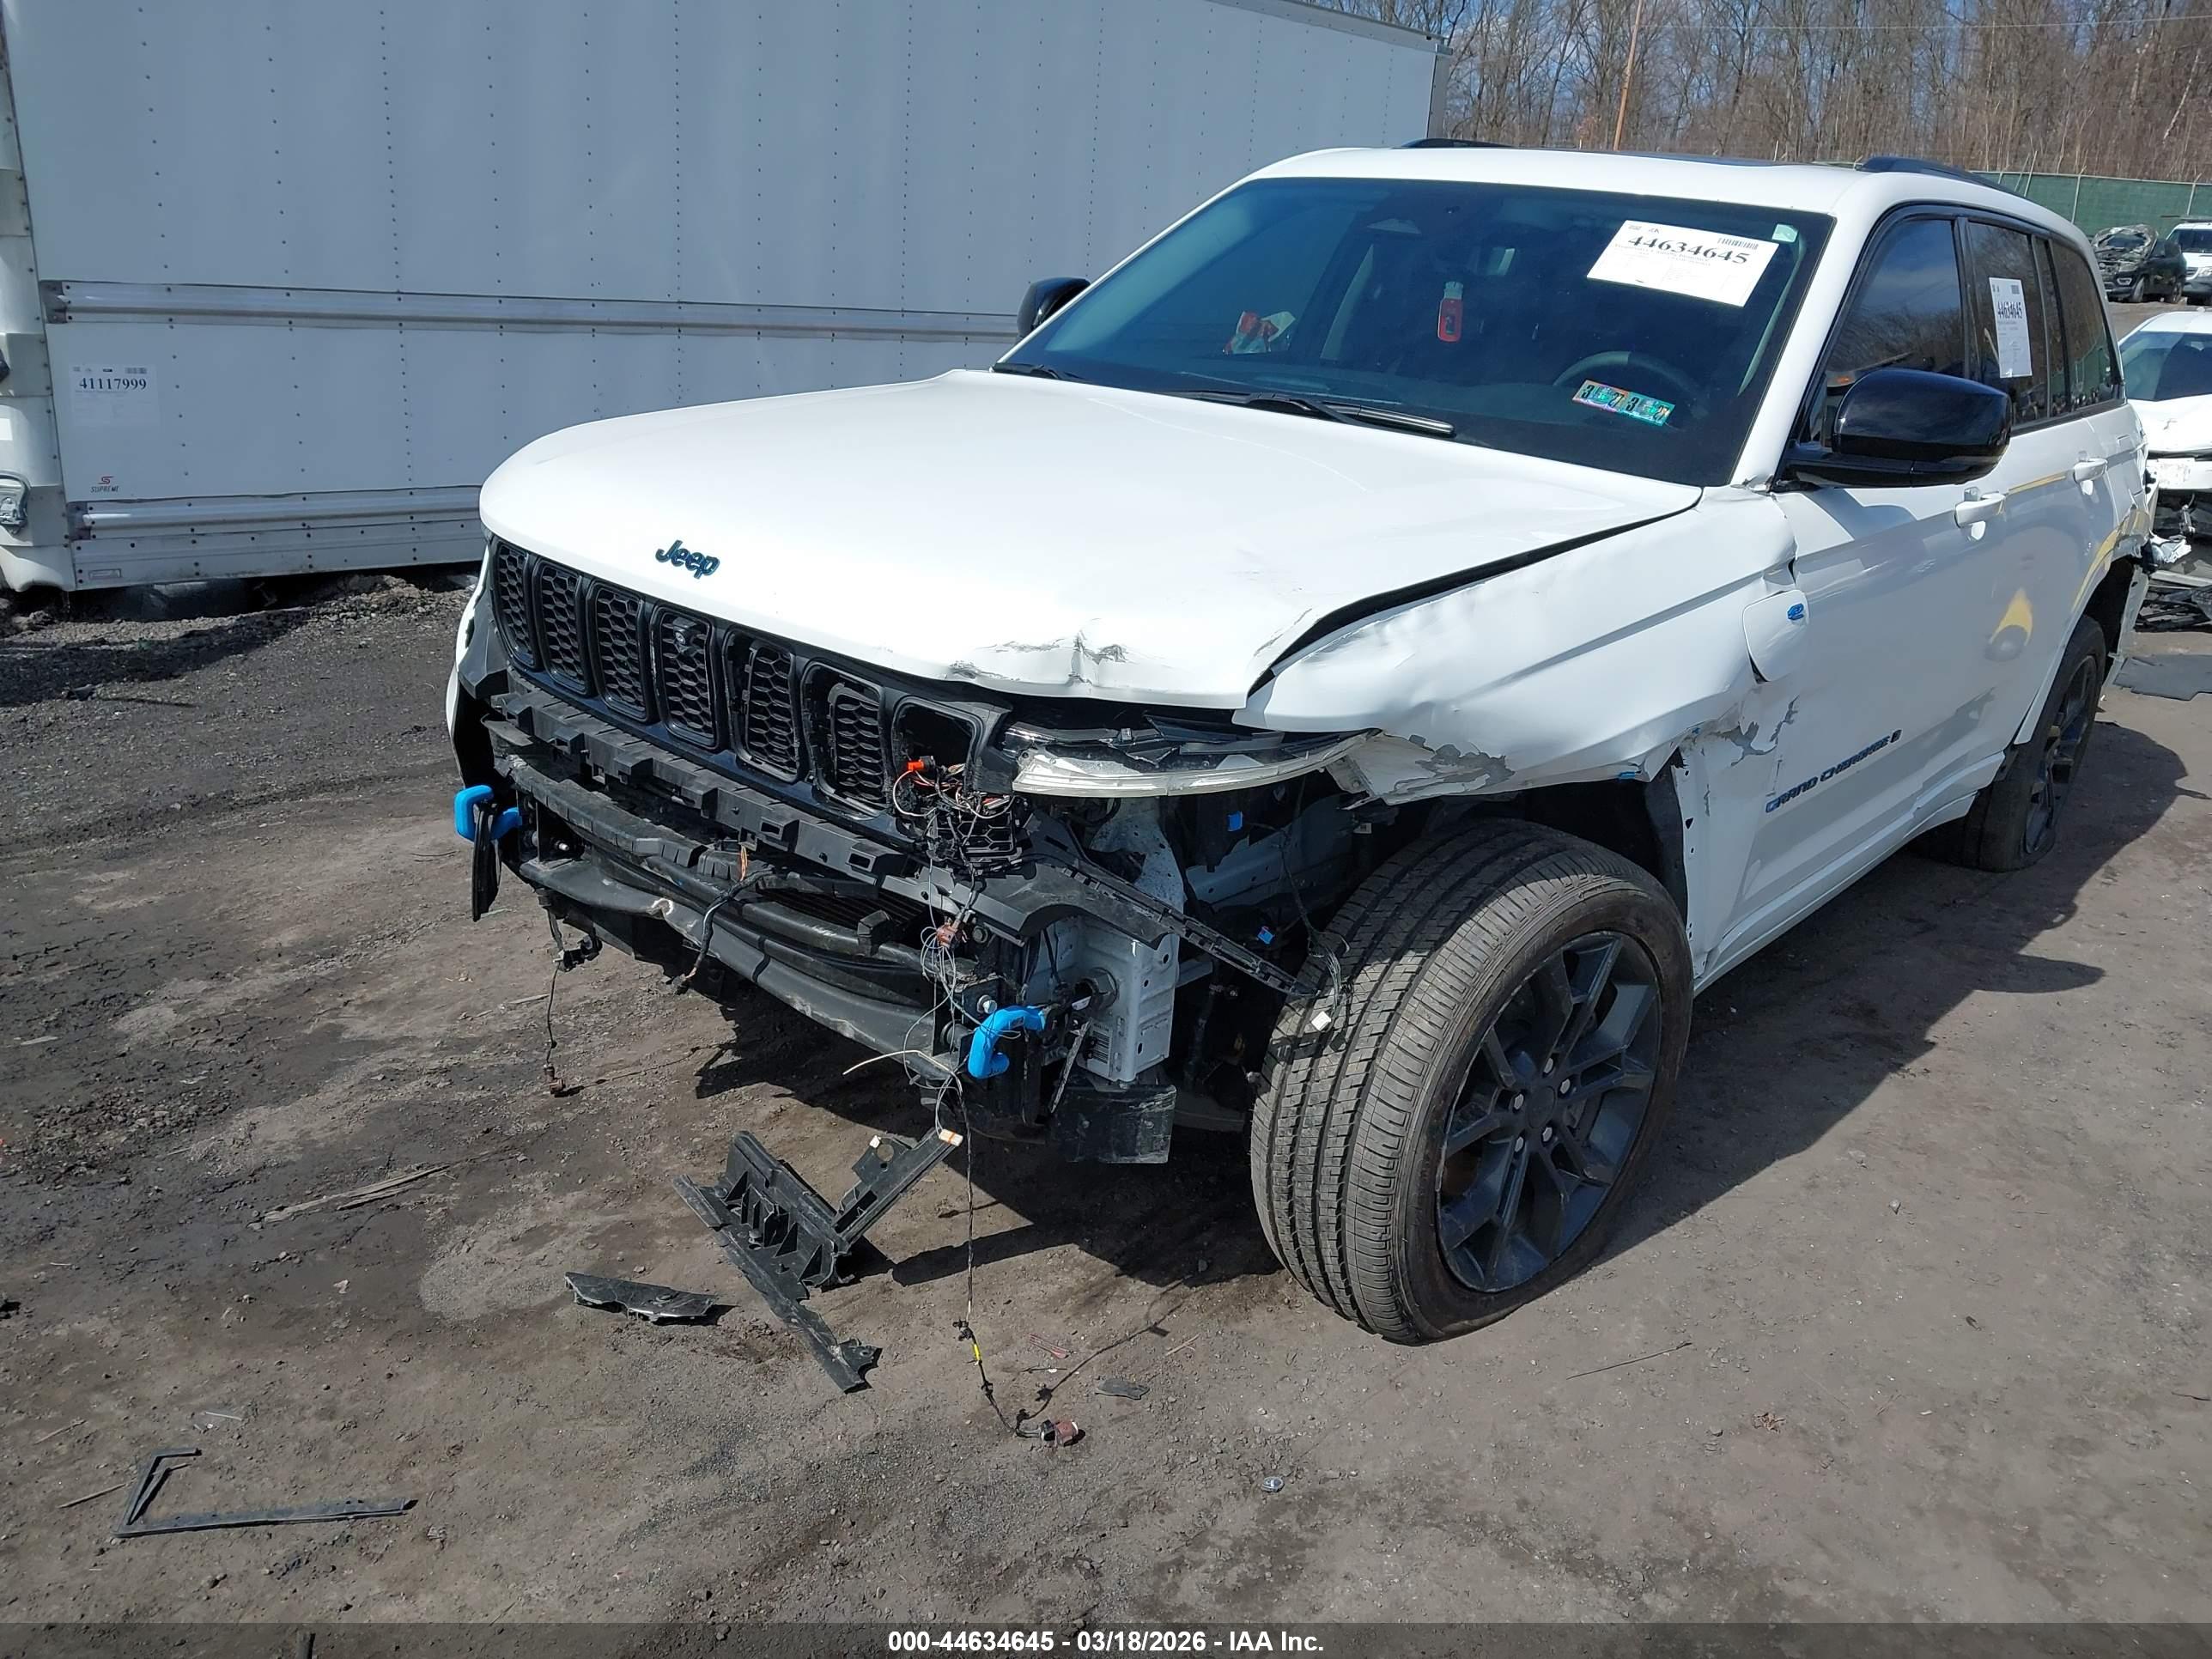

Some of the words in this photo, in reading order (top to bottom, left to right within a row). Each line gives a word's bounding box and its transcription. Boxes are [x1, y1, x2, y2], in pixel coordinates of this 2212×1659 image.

[1628, 235, 1751, 264] 44634645
[79, 378, 147, 390] 41117999
[1581, 384, 1595, 399] 3
[1626, 397, 1639, 412] 3
[655, 539, 720, 580] Jeep
[1765, 776, 1819, 813] GRAND
[1820, 736, 1891, 782] CHEROKEE
